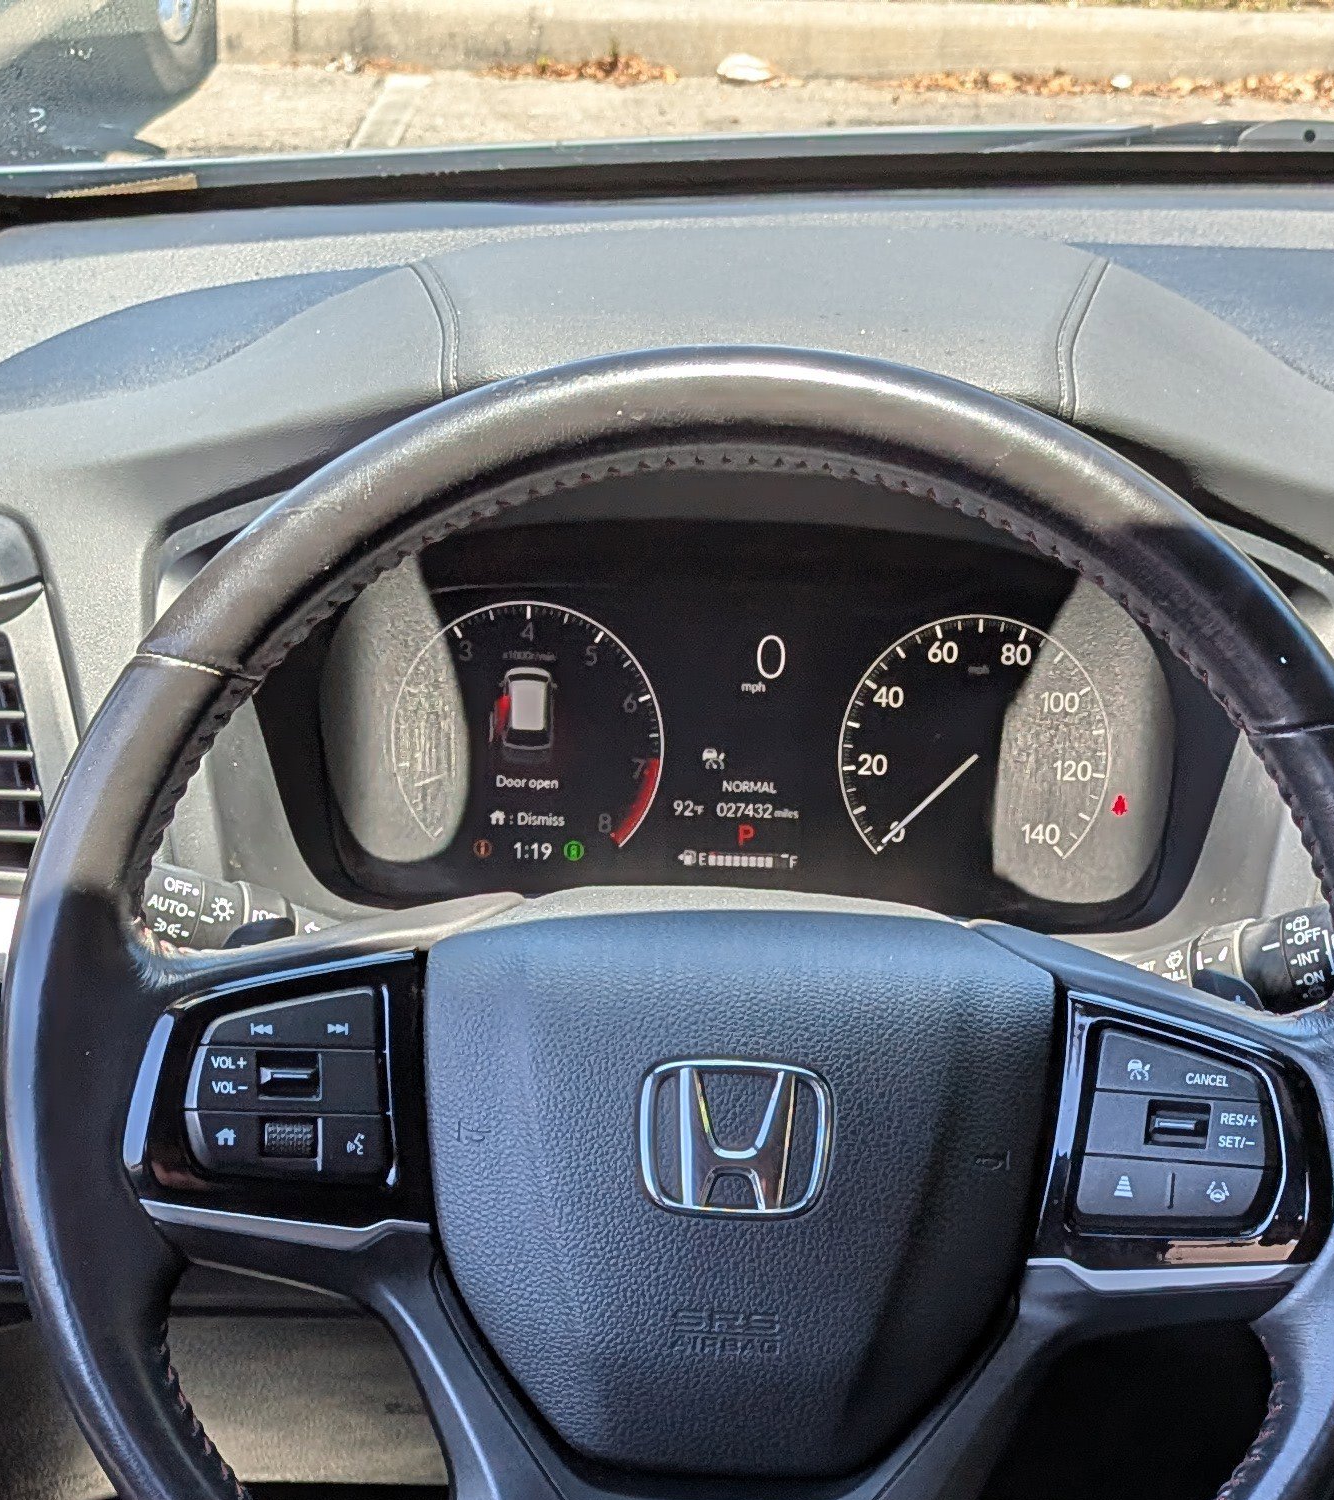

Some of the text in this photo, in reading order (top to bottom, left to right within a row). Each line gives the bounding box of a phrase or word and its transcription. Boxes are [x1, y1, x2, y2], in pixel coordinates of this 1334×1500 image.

[520, 622, 535, 641] 4
[585, 645, 598, 667] 5
[756, 634, 786, 680] 0
[927, 640, 959, 664] 60
[1000, 642, 1032, 666] 80
[740, 681, 766, 695] mph
[872, 685, 904, 709] 40
[623, 692, 638, 714] 6
[1039, 691, 1080, 713] 100
[857, 753, 888, 776] 20
[1053, 759, 1092, 781] 120
[495, 774, 559, 791] Door open
[721, 780, 777, 795] NORMAL
[517, 811, 566, 827] Dismiss
[716, 802, 773, 819] 027432
[773, 807, 799, 819] miles
[598, 812, 613, 833] 8
[737, 823, 756, 847] P
[1021, 823, 1061, 846] 140
[513, 842, 553, 860] 1:19
[698, 852, 799, 869] E F
[163, 876, 193, 896] OFF
[147, 894, 189, 918] AUTO
[1293, 927, 1322, 946] OFF
[1296, 948, 1321, 967] INT
[1303, 970, 1326, 986] ON
[1185, 1072, 1229, 1087] CANCEL
[1220, 1112, 1258, 1127] RES/+
